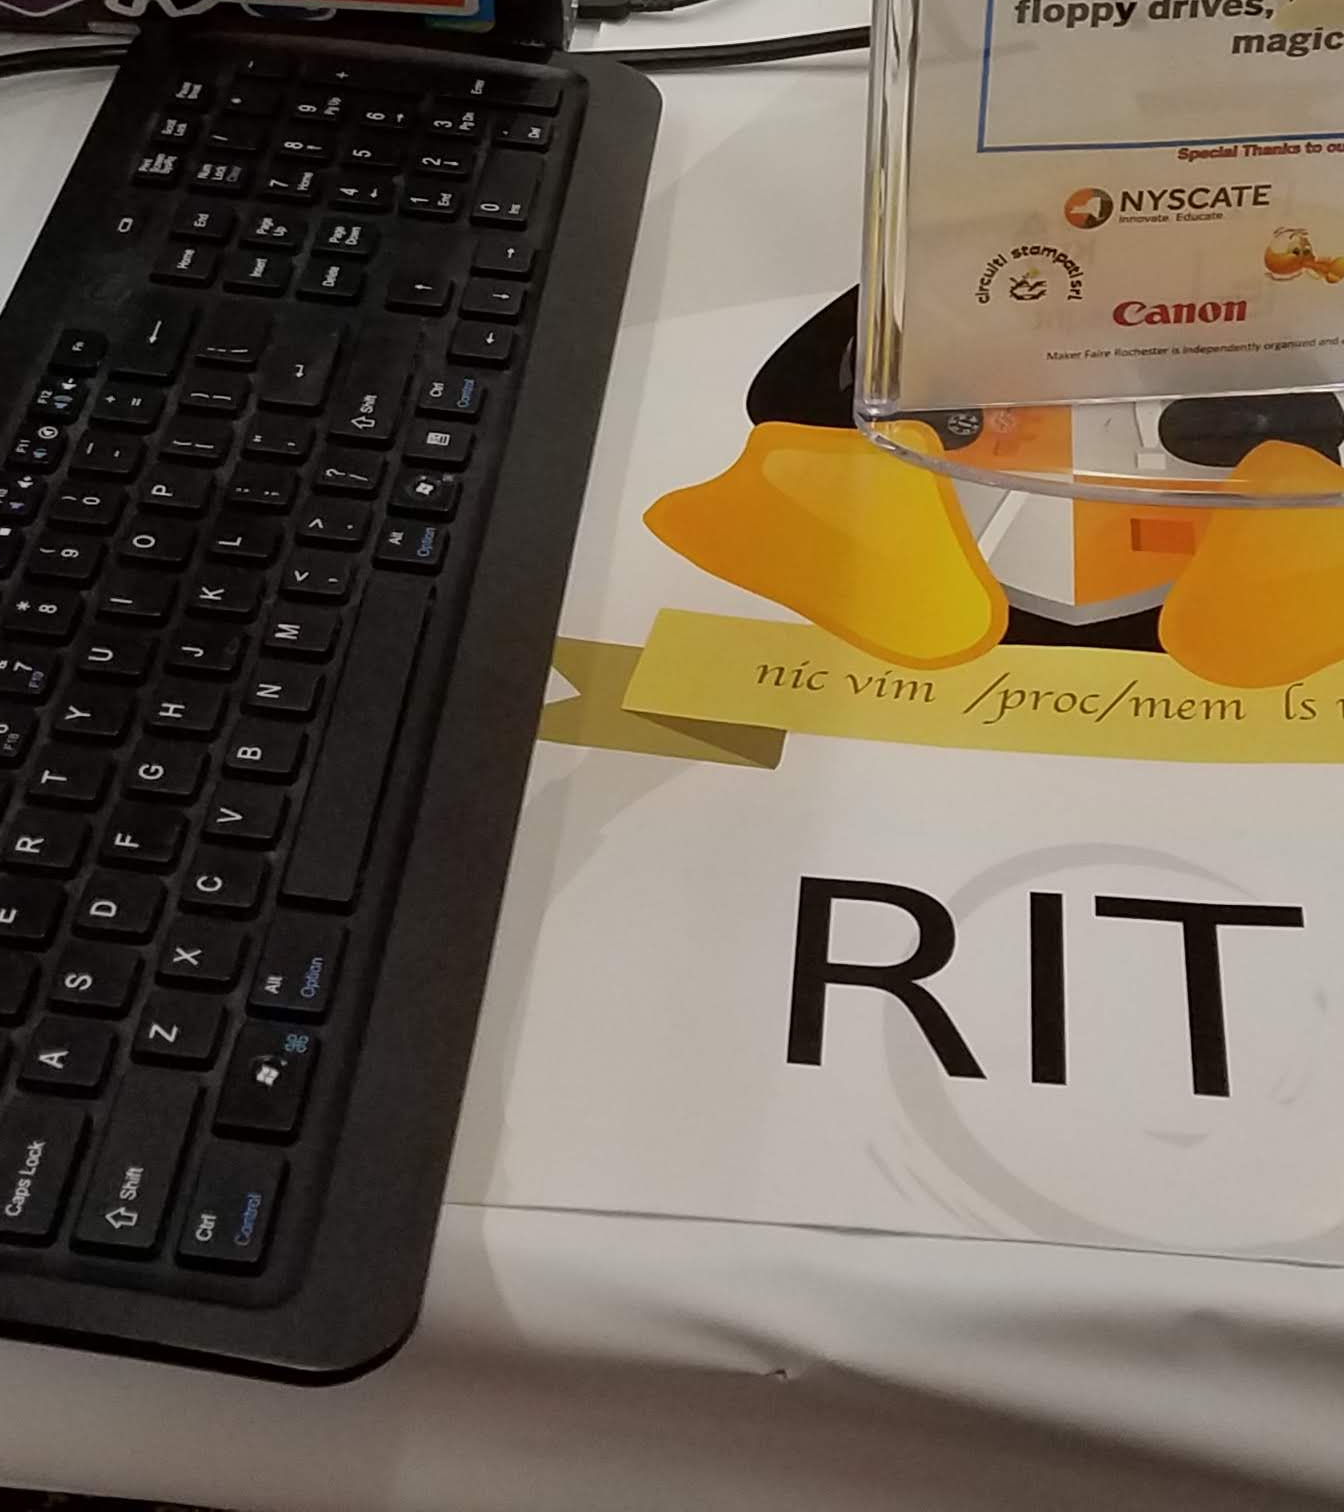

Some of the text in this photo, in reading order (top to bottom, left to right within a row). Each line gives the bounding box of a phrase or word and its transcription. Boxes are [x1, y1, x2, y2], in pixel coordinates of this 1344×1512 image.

[1178, 146, 1237, 161] Special
[1243, 143, 1301, 158] Thanks
[1306, 143, 1322, 155] to
[1120, 184, 1273, 213] NYSCATE
[1010, 245, 1084, 280] stampati
[1112, 300, 1248, 327] Canon
[754, 655, 828, 692] nic
[844, 666, 937, 705] vim
[961, 666, 1248, 727] /proc/mem
[1280, 678, 1325, 724] ls
[301, 956, 324, 999] Option
[783, 876, 1304, 1100] RIT
[5, 1140, 46, 1218] Caps Lock
[120, 1166, 144, 1202] Shift
[196, 1213, 217, 1243] Ctrl
[235, 1192, 263, 1247] Control
